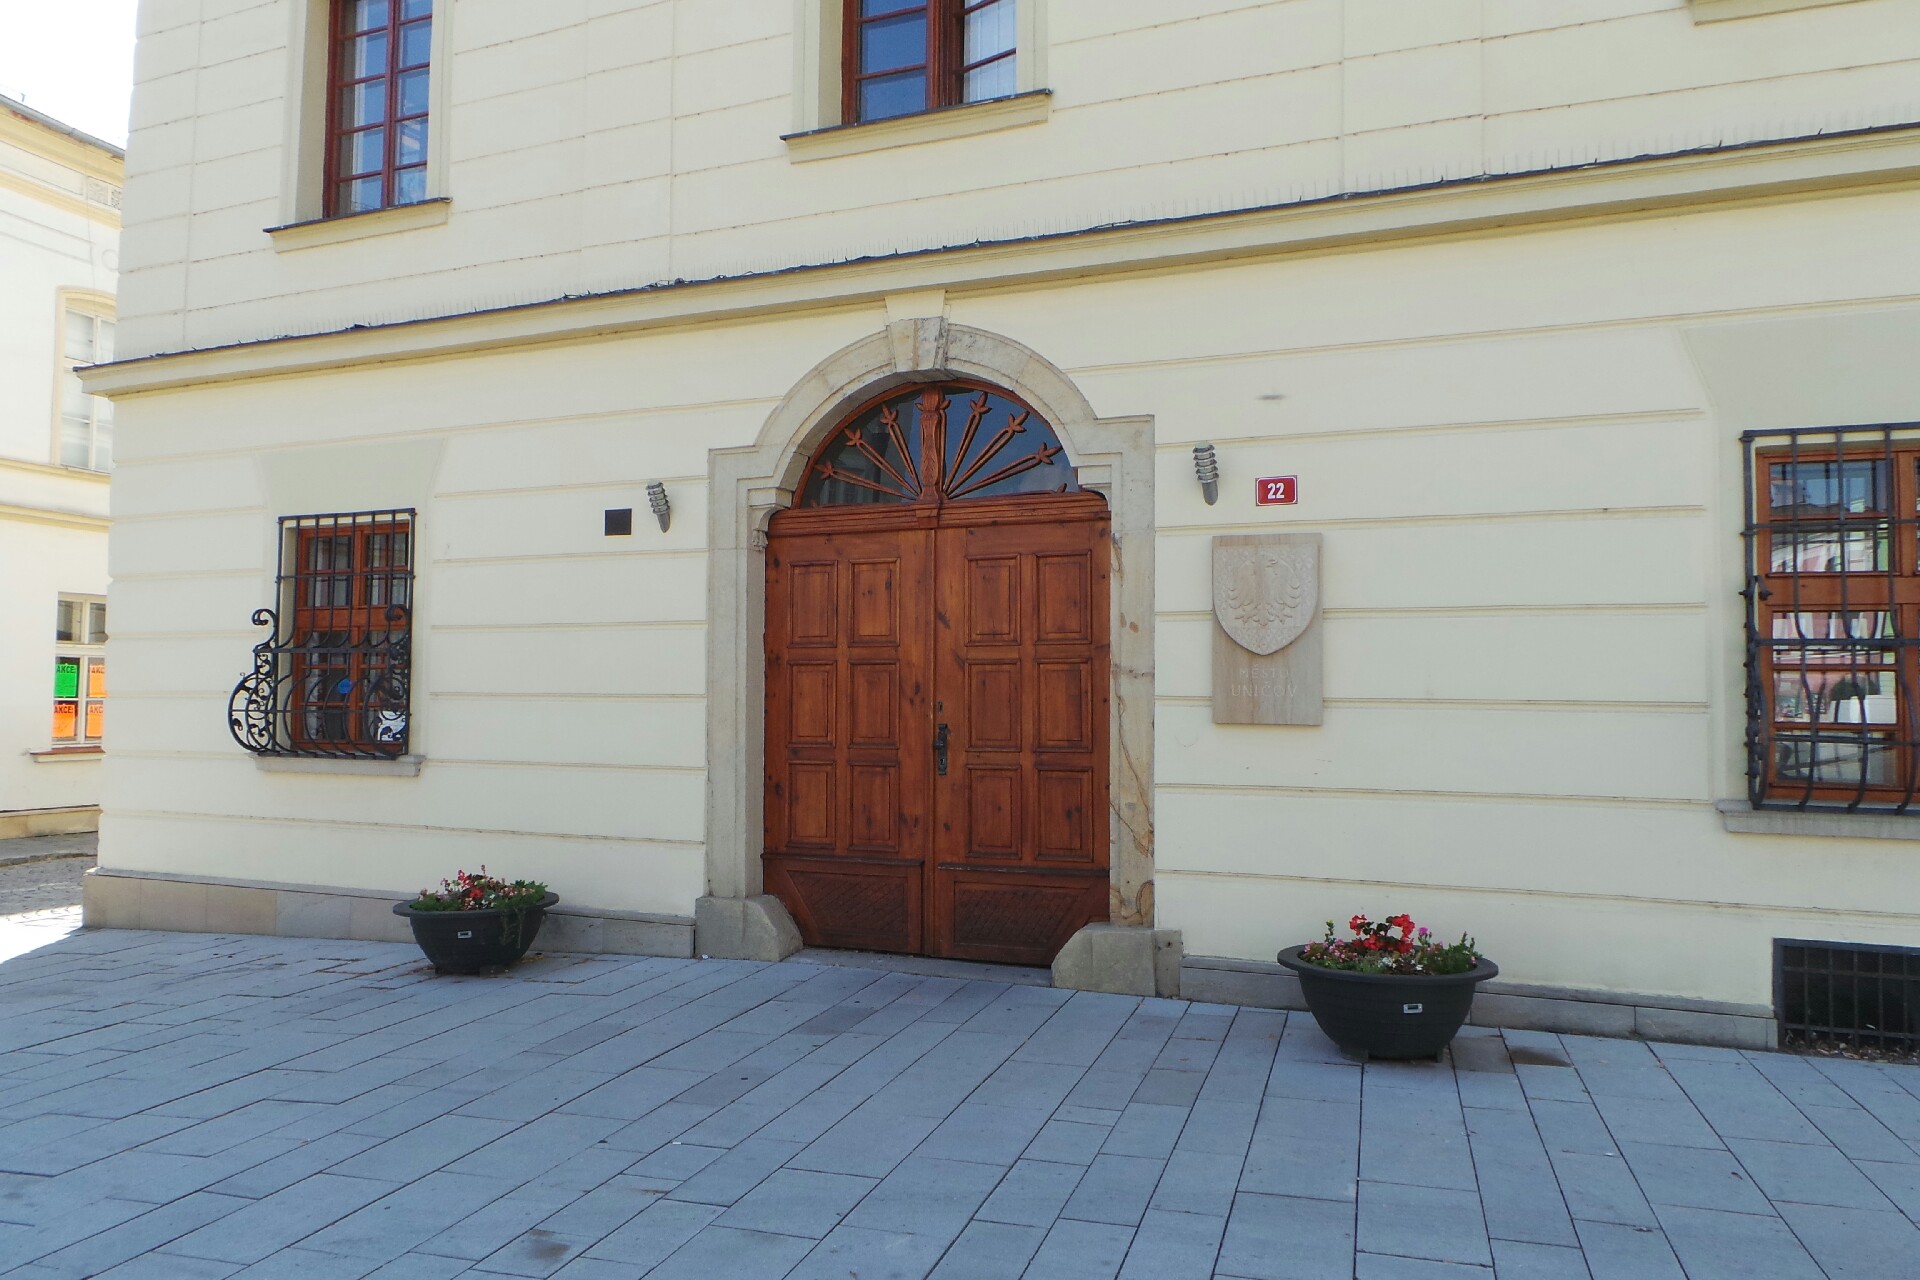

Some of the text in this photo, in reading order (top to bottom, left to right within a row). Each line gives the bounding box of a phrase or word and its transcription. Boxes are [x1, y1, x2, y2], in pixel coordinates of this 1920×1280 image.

[1267, 482, 1285, 499] 22
[1238, 664, 1289, 679] MĚSTO
[1231, 682, 1298, 697] UNIČOV
